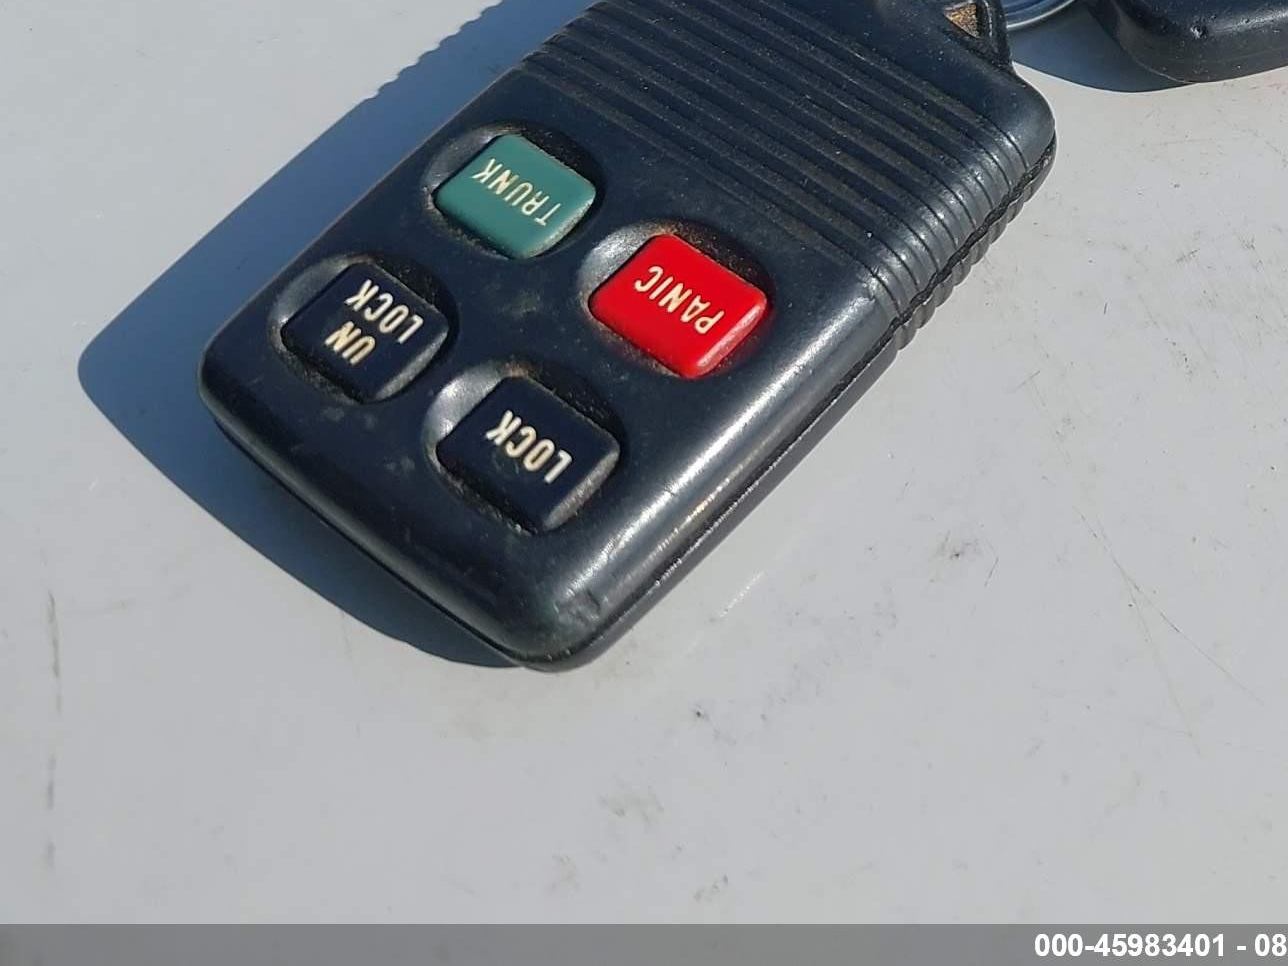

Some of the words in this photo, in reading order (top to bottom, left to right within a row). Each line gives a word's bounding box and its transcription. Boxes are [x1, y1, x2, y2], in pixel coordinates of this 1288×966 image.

[471, 156, 562, 226] TRUNK
[345, 278, 424, 344] LOCK
[634, 265, 726, 335] PANIC
[324, 320, 377, 366] UN
[485, 410, 573, 484] LOCK
